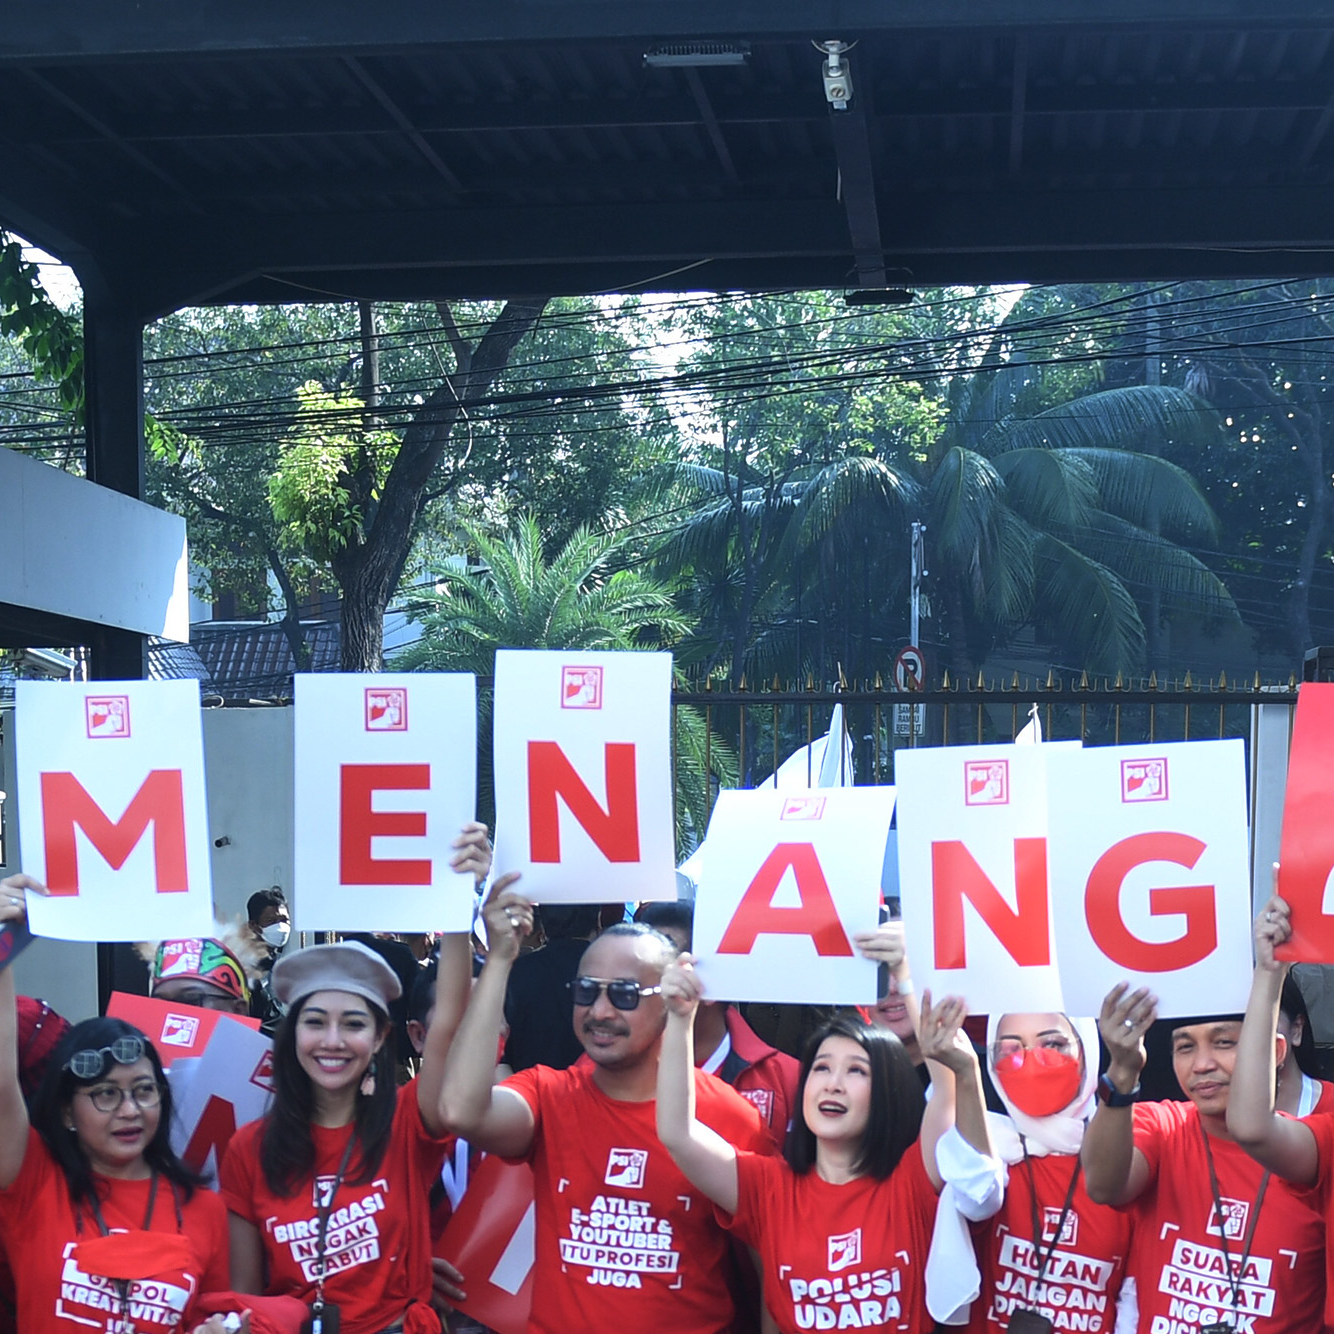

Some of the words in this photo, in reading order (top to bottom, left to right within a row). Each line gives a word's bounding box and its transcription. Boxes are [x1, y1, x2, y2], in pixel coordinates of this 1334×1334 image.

[896, 724, 922, 733] BERUT
[897, 714, 920, 723] RAMU
[527, 740, 642, 864] N
[40, 769, 189, 897] M
[339, 763, 433, 886] E
[716, 842, 855, 958] A
[931, 837, 1050, 970] N
[1084, 830, 1218, 974] G
[274, 1192, 385, 1243] BIROKRASI
[571, 1208, 656, 1233] E-SPORT
[657, 1219, 673, 1235] &
[591, 1195, 651, 1215] ATLET
[297, 1221, 372, 1257] NGAK
[569, 1224, 672, 1250] YOUTUBER
[308, 1243, 373, 1276] GABUT
[563, 1244, 591, 1260] ITU
[595, 1250, 673, 1268] PROFESI
[1012, 1244, 1101, 1285] HUTAN
[1180, 1247, 1260, 1280] SUARA
[88, 1274, 170, 1304] GAPOL
[586, 1268, 642, 1288] JUGA
[789, 1267, 901, 1303] POLUSI
[995, 1271, 1107, 1312] JANGAN
[1168, 1272, 1266, 1310] RAKYAT
[61, 1283, 182, 1327] KREATVITAS
[794, 1295, 901, 1330] UDARA
[995, 1295, 1103, 1332] DIBANG
